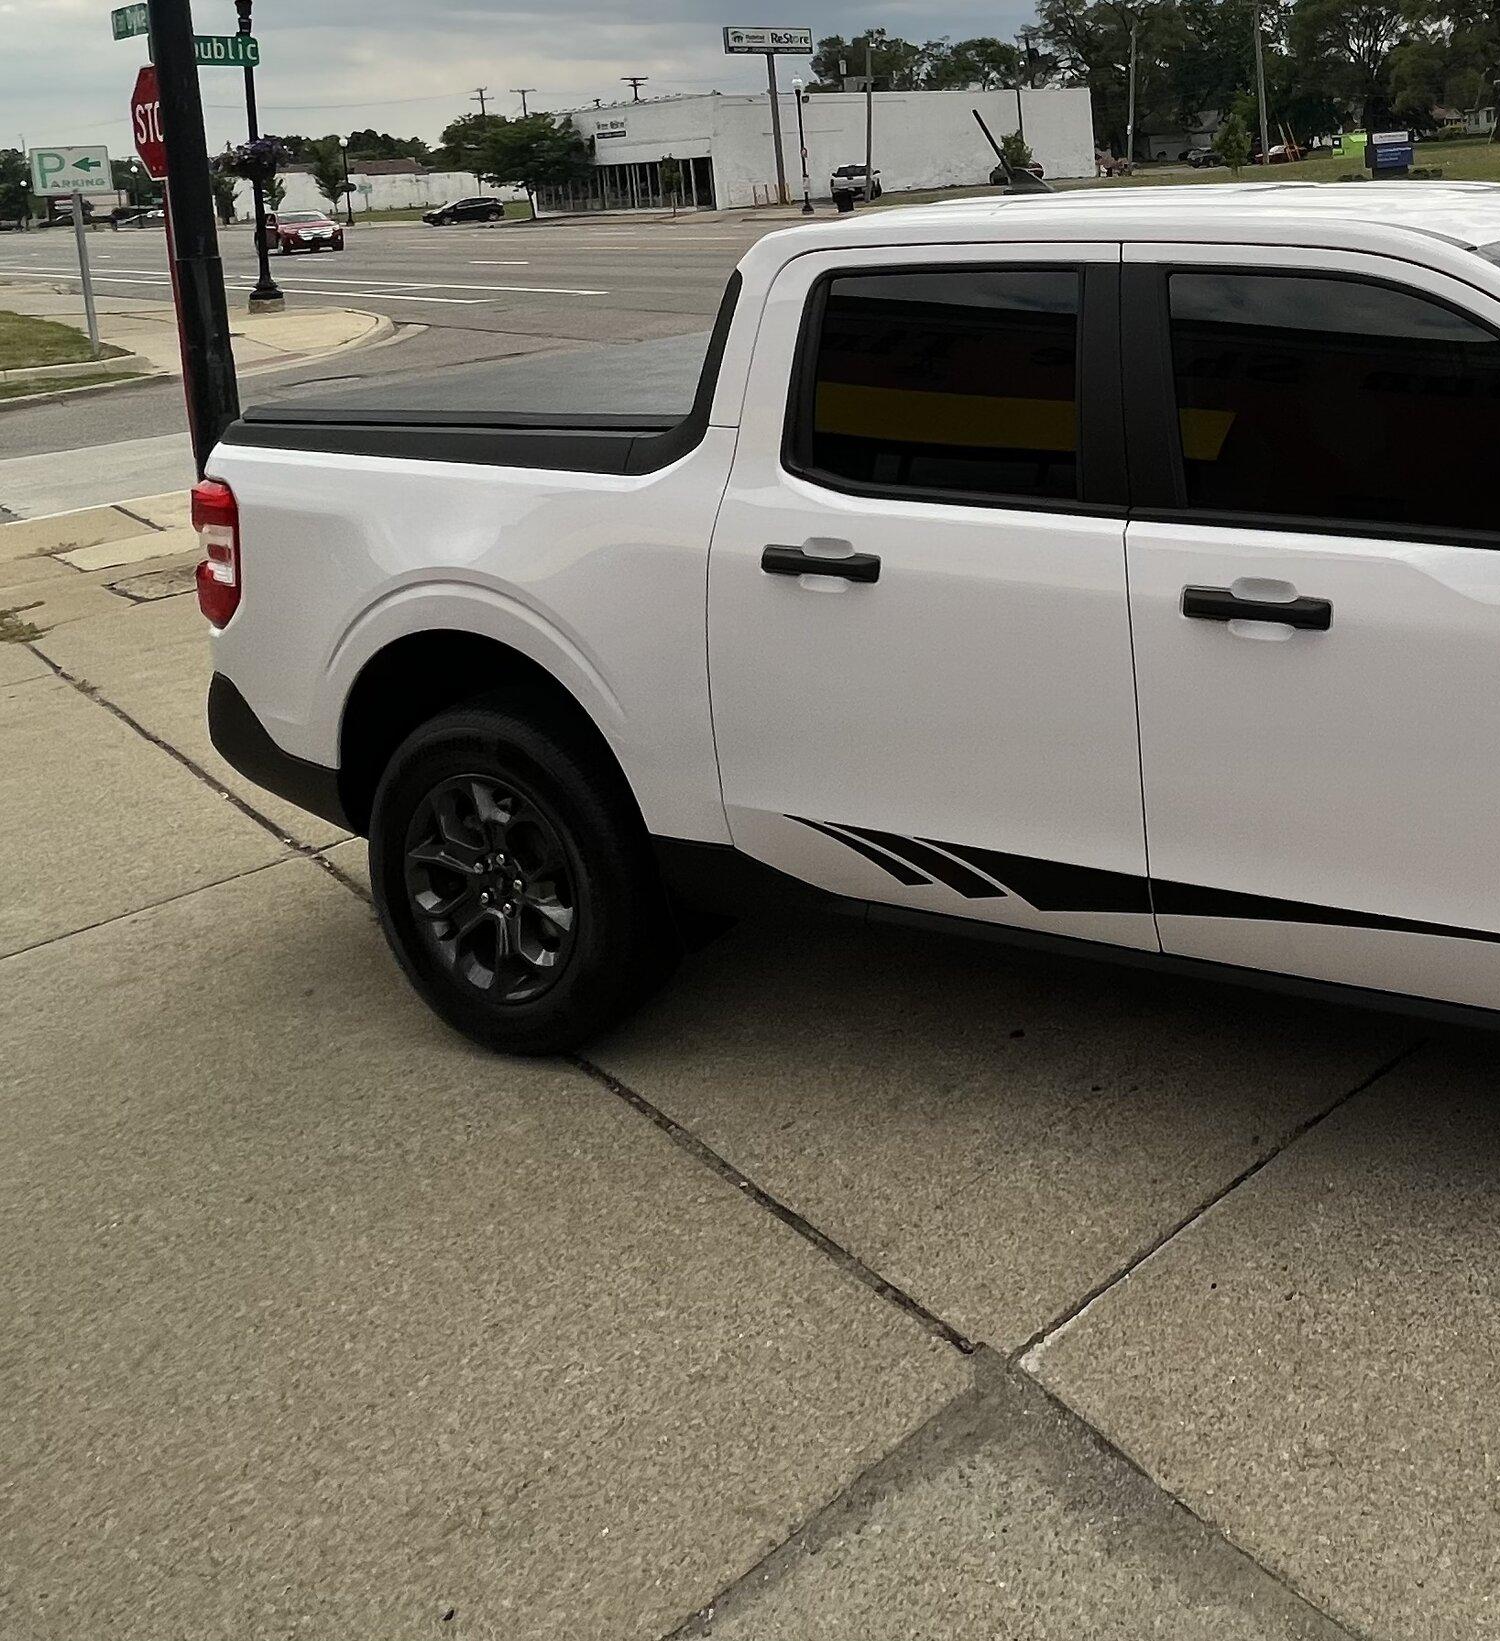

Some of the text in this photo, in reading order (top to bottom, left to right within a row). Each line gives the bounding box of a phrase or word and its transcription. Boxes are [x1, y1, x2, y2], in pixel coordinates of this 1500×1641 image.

[195, 37, 258, 61] ublic
[770, 32, 810, 45] ReStore
[135, 101, 164, 144] STO
